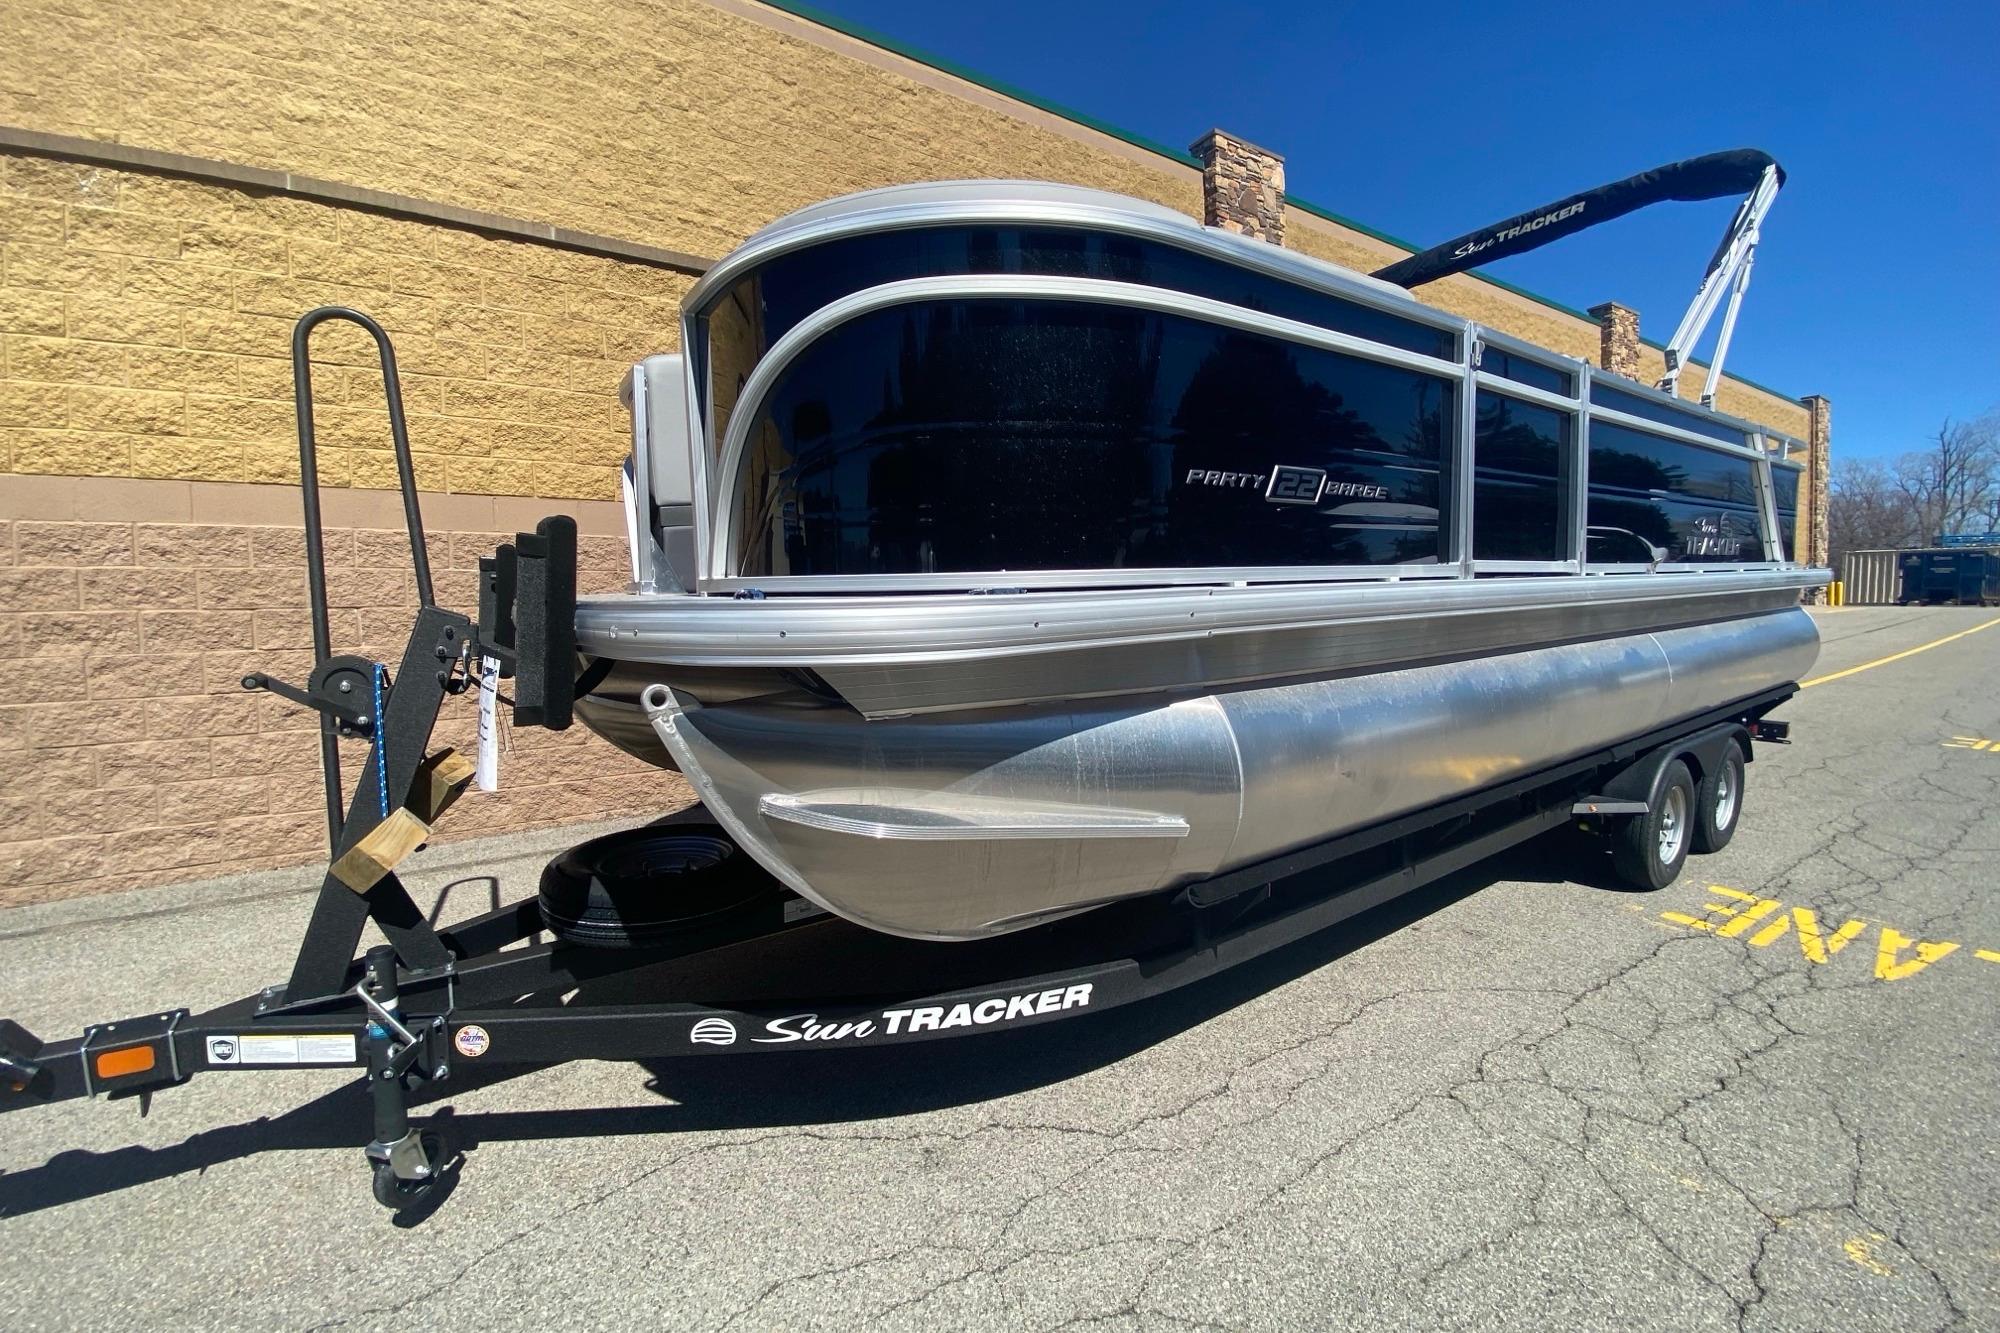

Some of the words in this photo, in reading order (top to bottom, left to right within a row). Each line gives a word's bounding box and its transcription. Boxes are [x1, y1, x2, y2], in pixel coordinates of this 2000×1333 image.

[1449, 238, 1495, 260] Sun
[1495, 201, 1586, 243] TRACKER
[1185, 468, 1266, 489] PARTY
[1276, 472, 1319, 497] 22
[1325, 481, 1389, 500] BARGE
[750, 1013, 877, 1043] Sun
[881, 982, 1094, 1035] TRACKER
